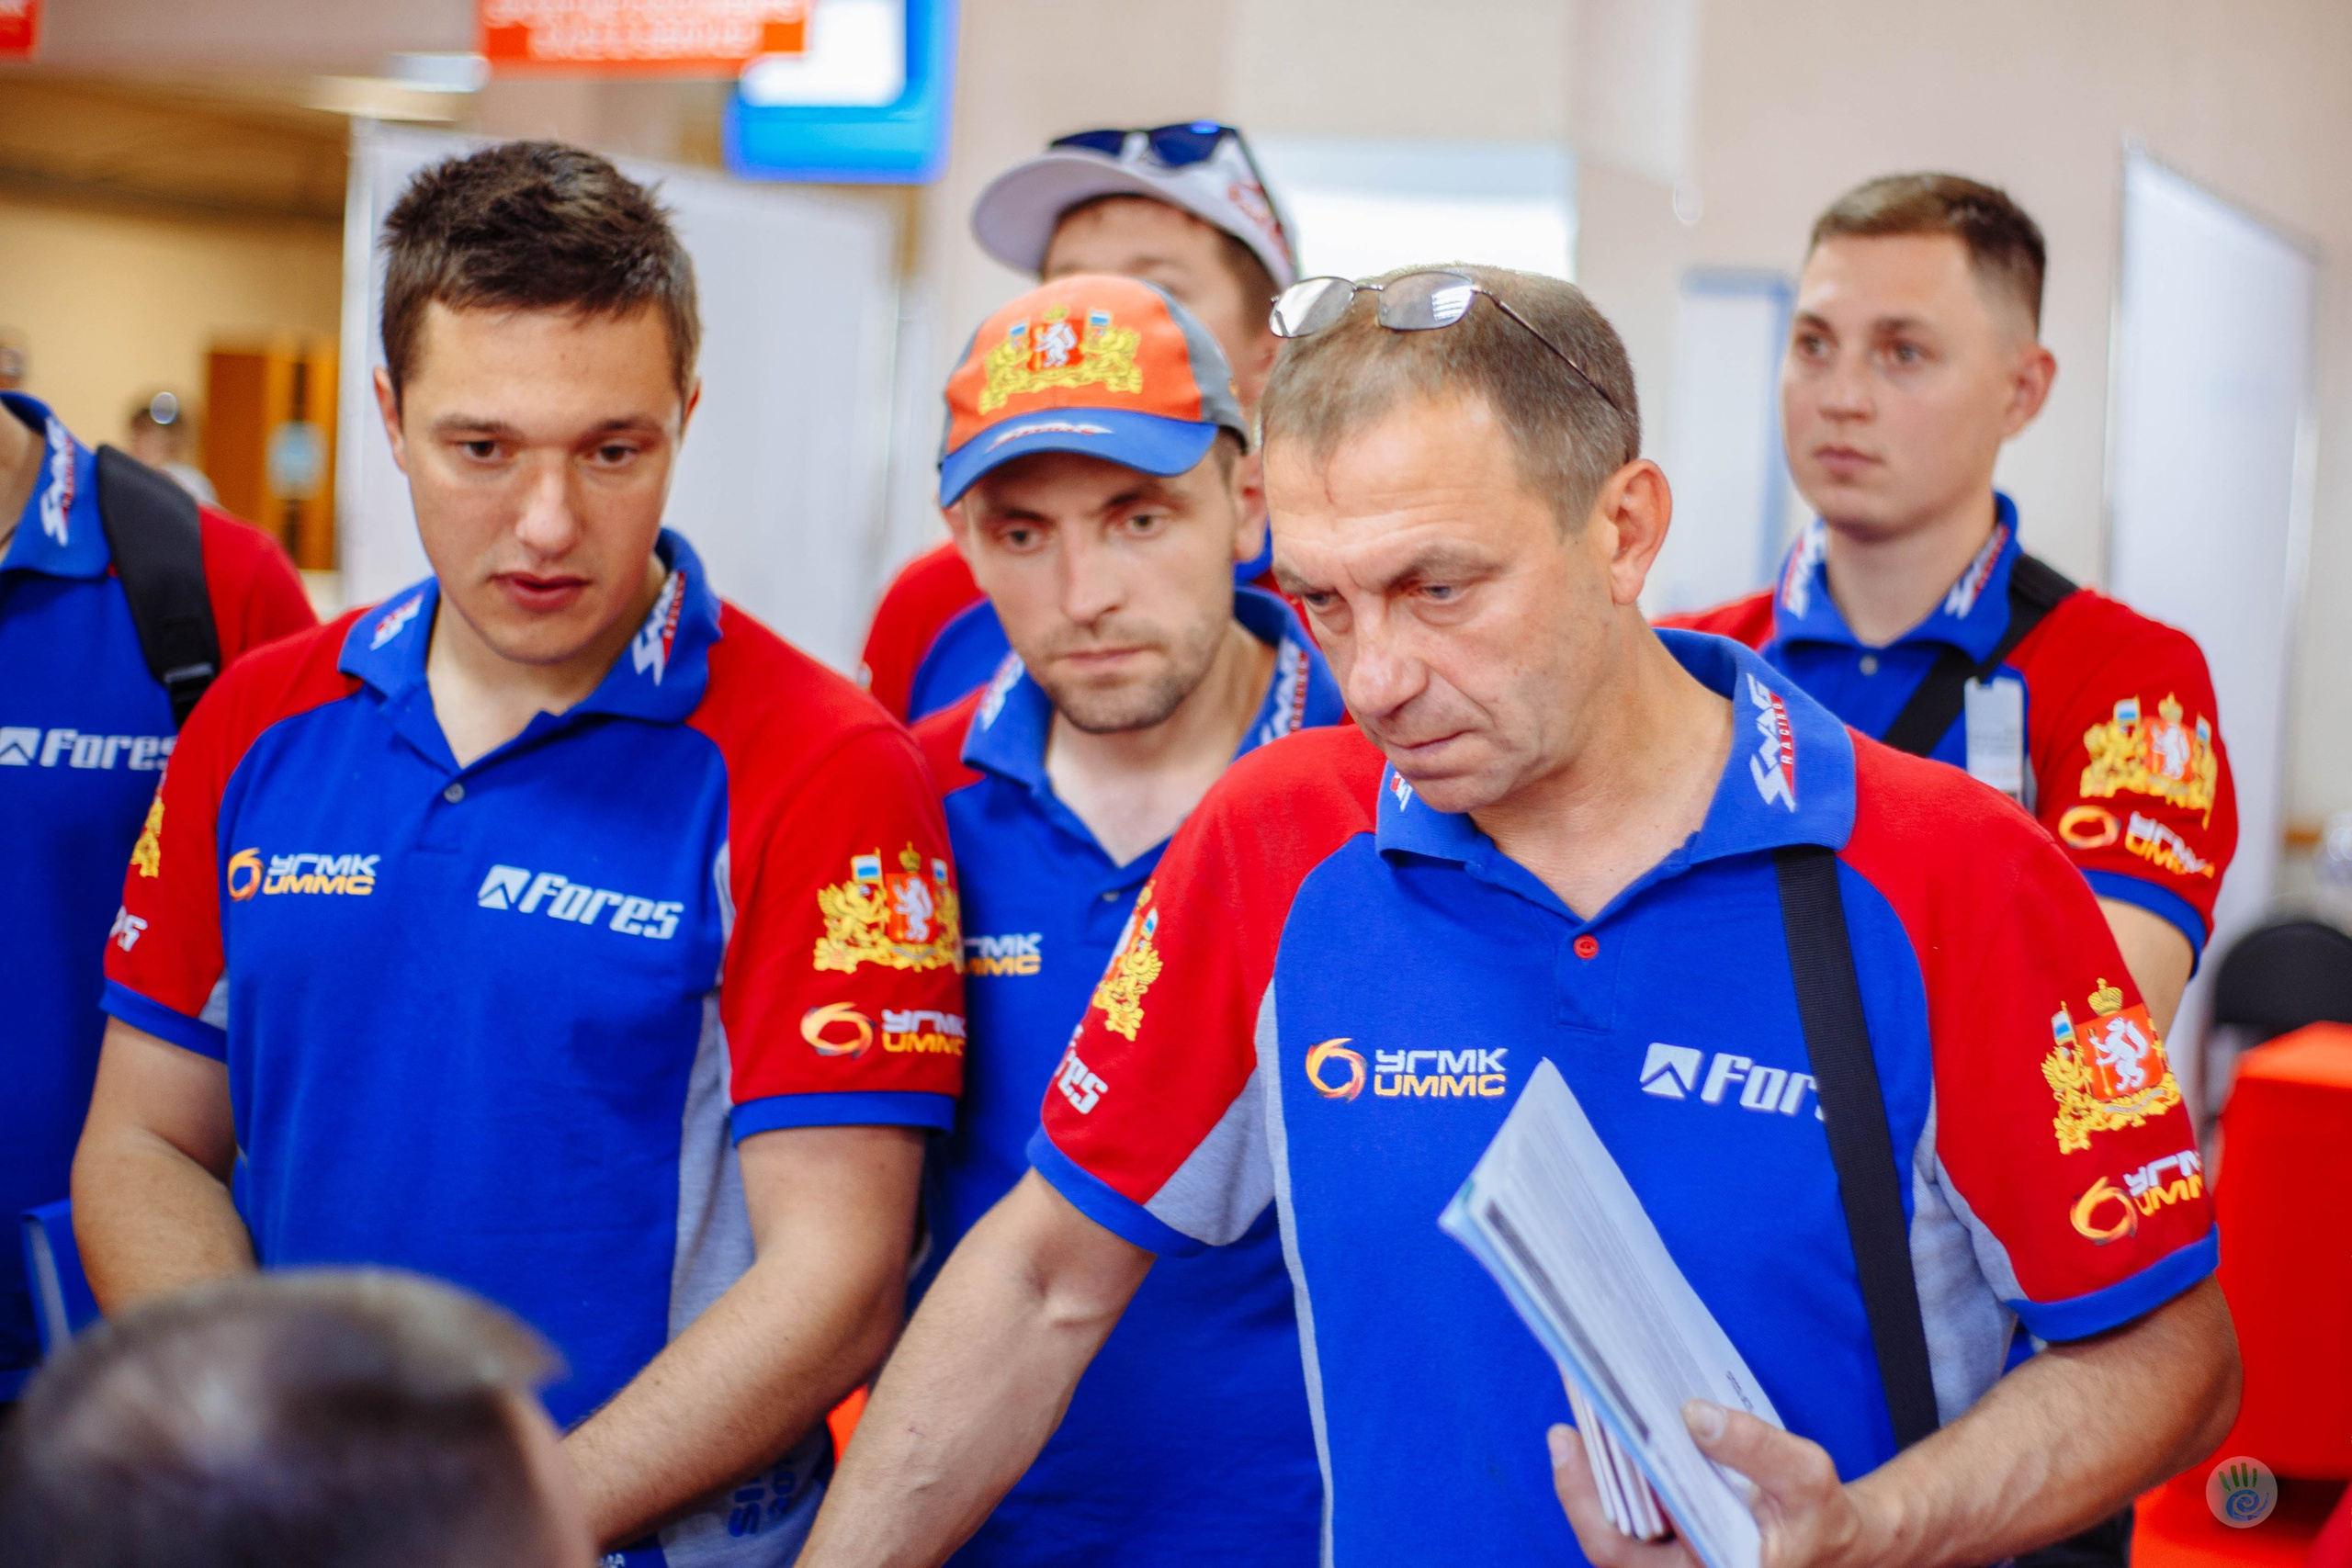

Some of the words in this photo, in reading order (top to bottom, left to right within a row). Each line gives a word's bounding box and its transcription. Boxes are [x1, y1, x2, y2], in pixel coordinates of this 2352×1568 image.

[266, 853, 381, 876] УГМК
[263, 874, 376, 896] UMMC
[517, 871, 685, 941] Fores
[1374, 1047, 1510, 1074] УГМК
[1374, 1073, 1507, 1098] UMMC
[1700, 1052, 1826, 1122] For
